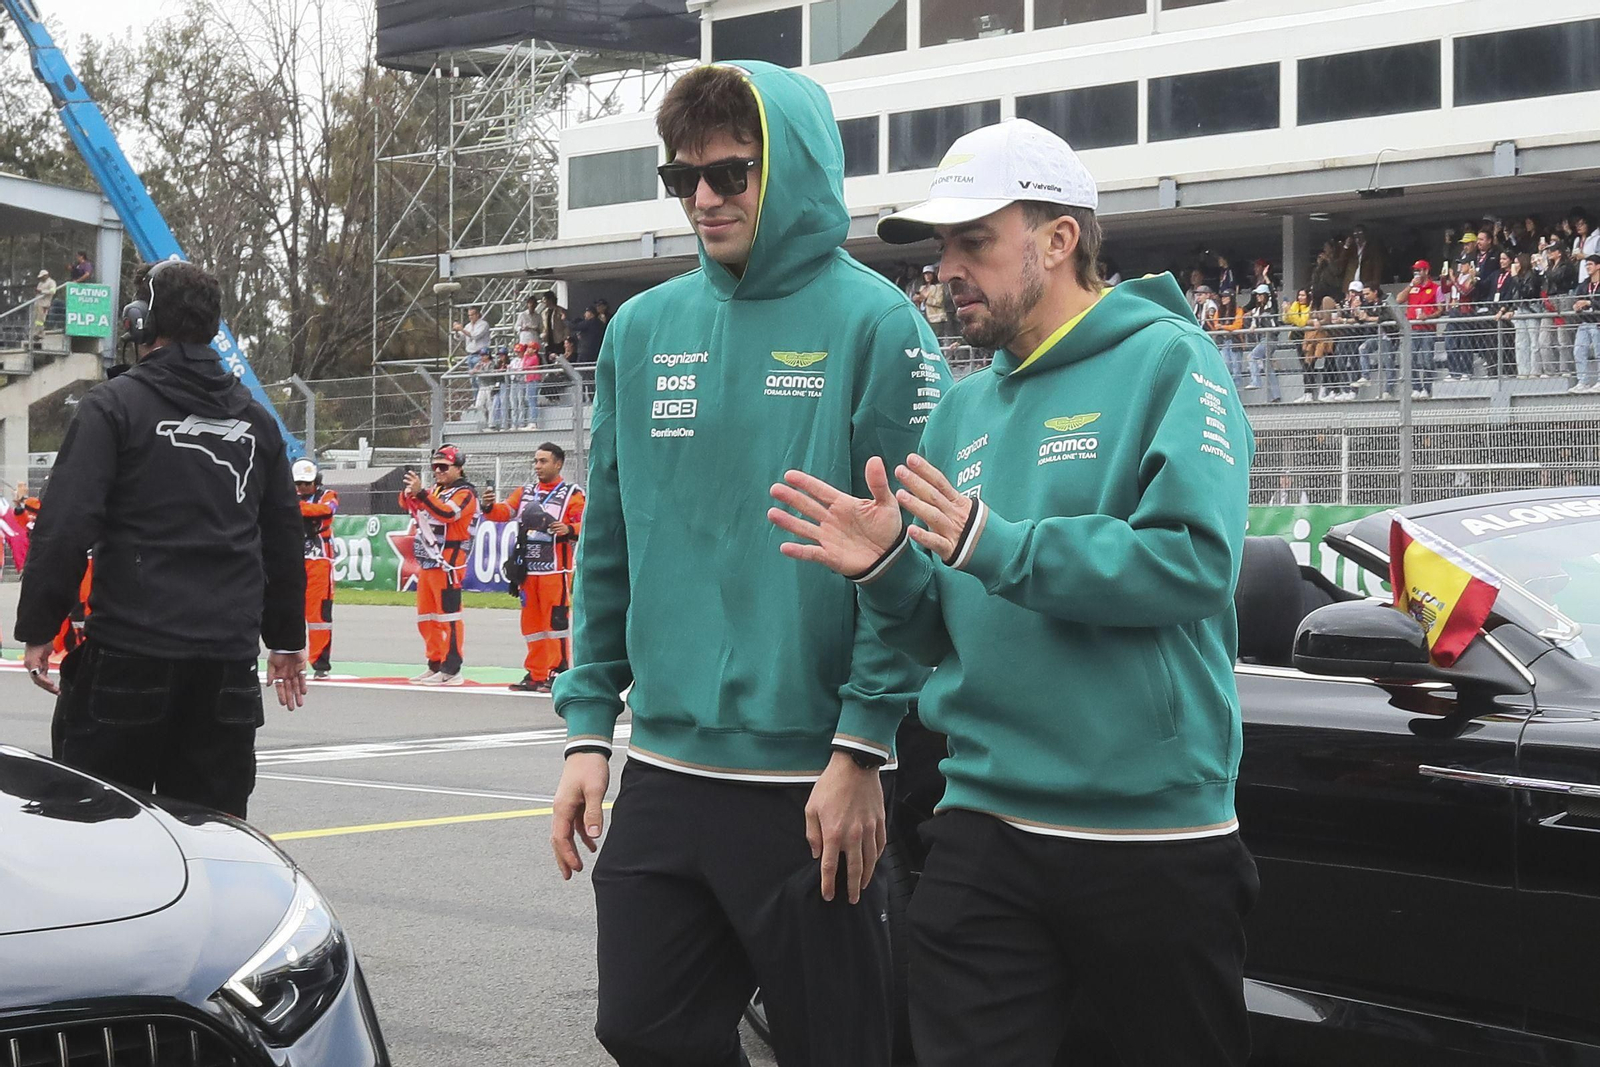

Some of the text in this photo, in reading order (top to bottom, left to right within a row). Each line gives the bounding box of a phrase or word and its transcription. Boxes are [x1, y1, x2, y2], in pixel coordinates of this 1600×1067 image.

[954, 175, 974, 184] TEAM
[70, 287, 108, 297] PLATINO
[68, 312, 109, 327] PLP A
[225, 352, 245, 378] XC
[653, 351, 708, 367] cognizant
[657, 375, 696, 391] BOSS
[766, 375, 825, 389] aramco
[654, 401, 695, 417] JCB
[651, 427, 695, 437] SentinelOne
[956, 433, 988, 461] cognizant
[1039, 438, 1098, 456] aramco
[1037, 455, 1061, 466] FORMULA
[957, 461, 981, 487] BOSS
